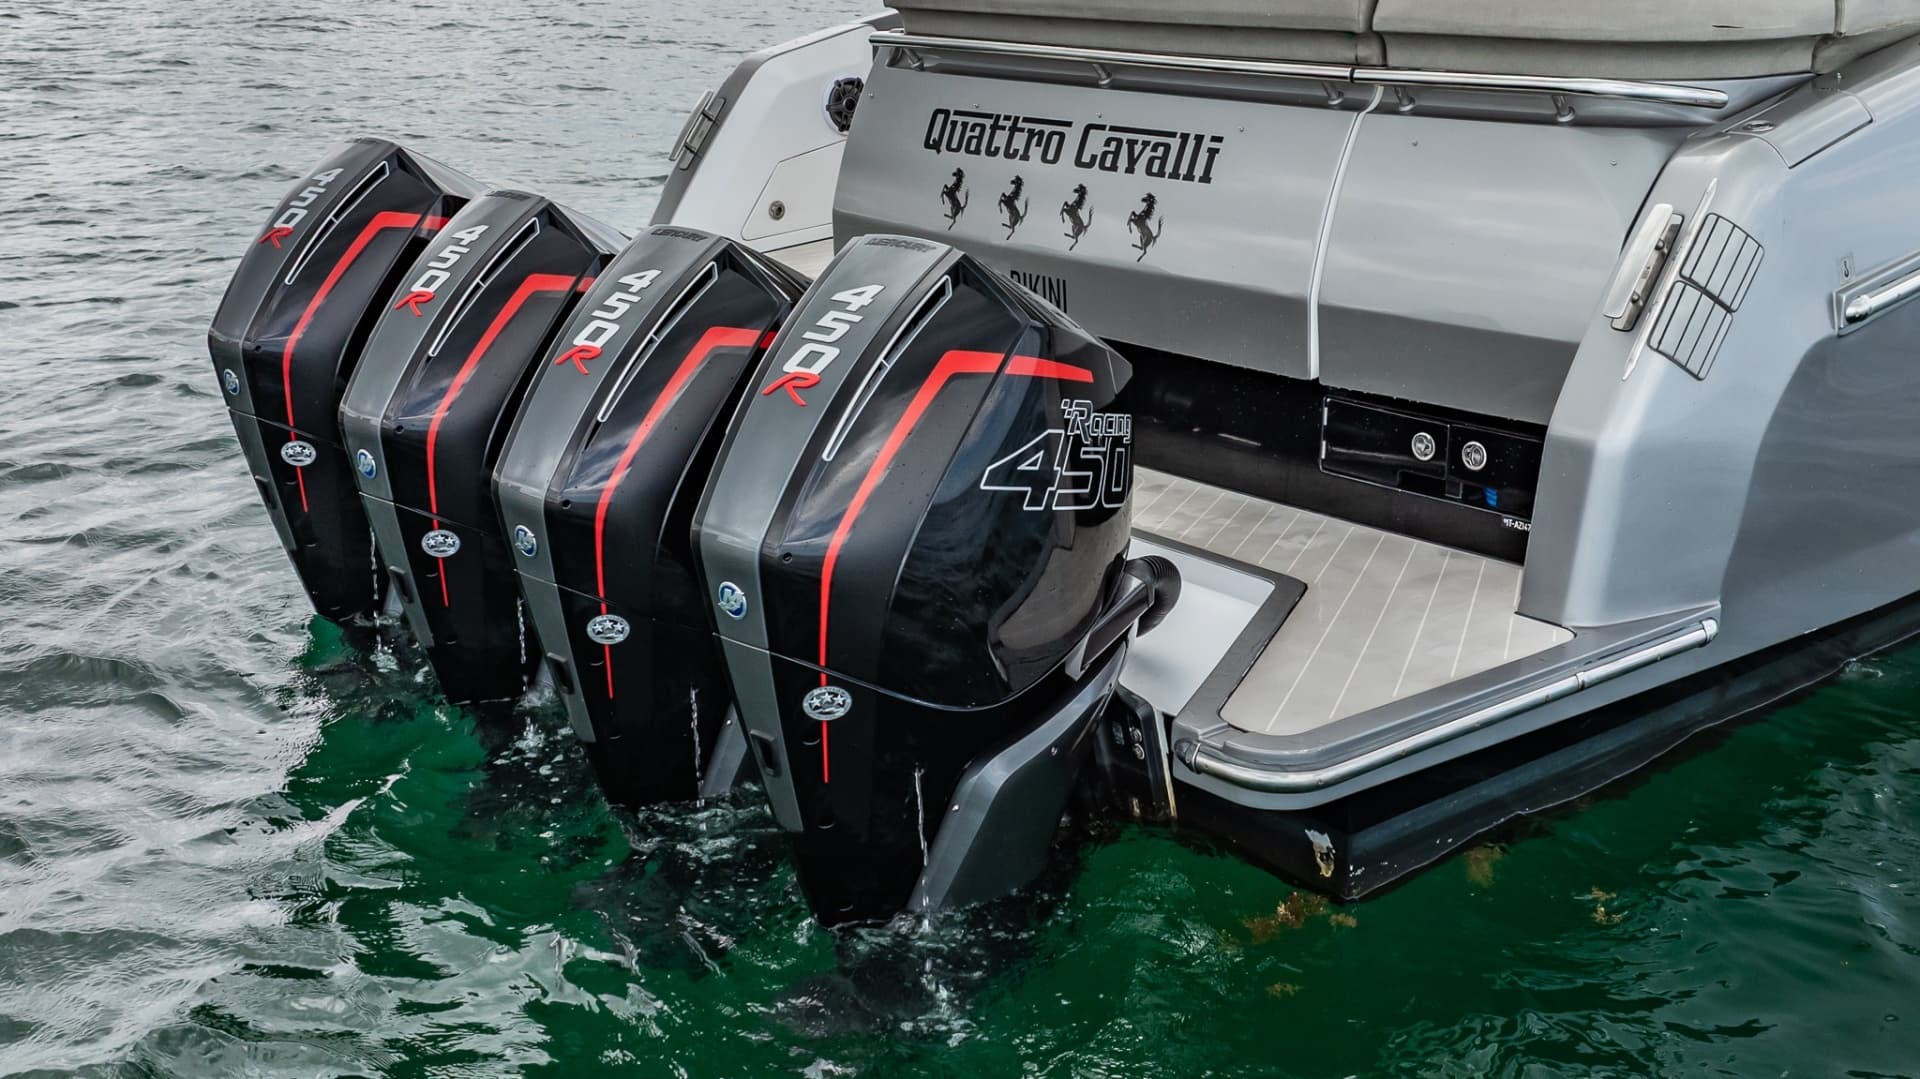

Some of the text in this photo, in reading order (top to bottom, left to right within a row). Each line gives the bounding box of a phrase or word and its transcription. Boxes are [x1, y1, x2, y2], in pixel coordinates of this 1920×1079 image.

[923, 107, 1225, 184] Quattro Cavalli
[1066, 399, 1132, 444] Racing
[980, 428, 1131, 511] 450
